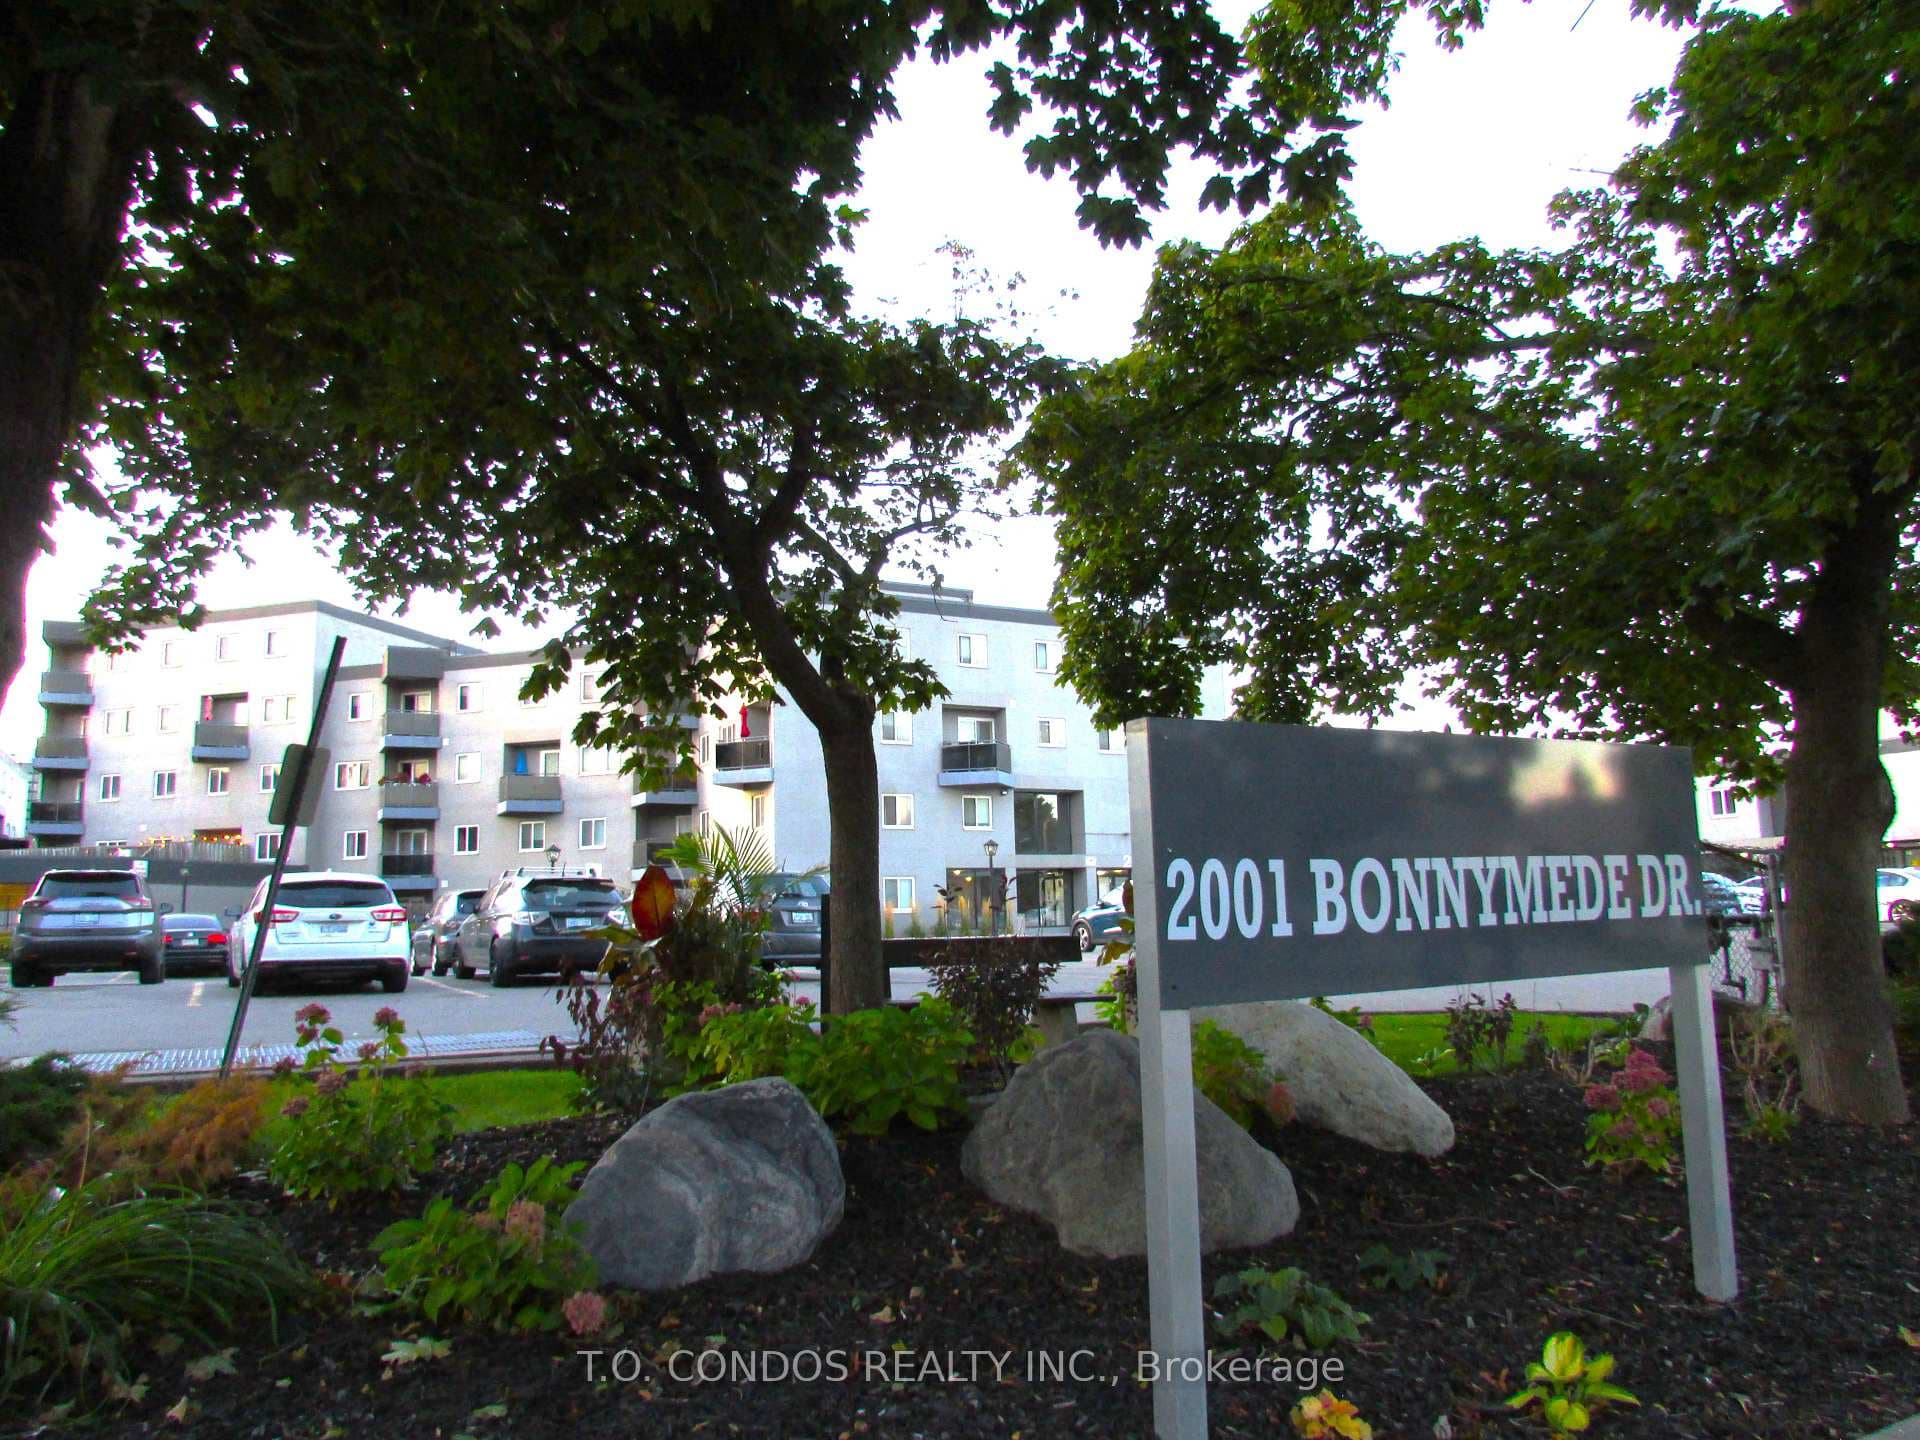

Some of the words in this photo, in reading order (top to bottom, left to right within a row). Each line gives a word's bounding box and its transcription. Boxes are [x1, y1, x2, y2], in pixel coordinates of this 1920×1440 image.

[1166, 857, 1293, 941] 2001
[1309, 854, 1632, 936] BONNYMEDE
[1636, 853, 1702, 918] DR.
